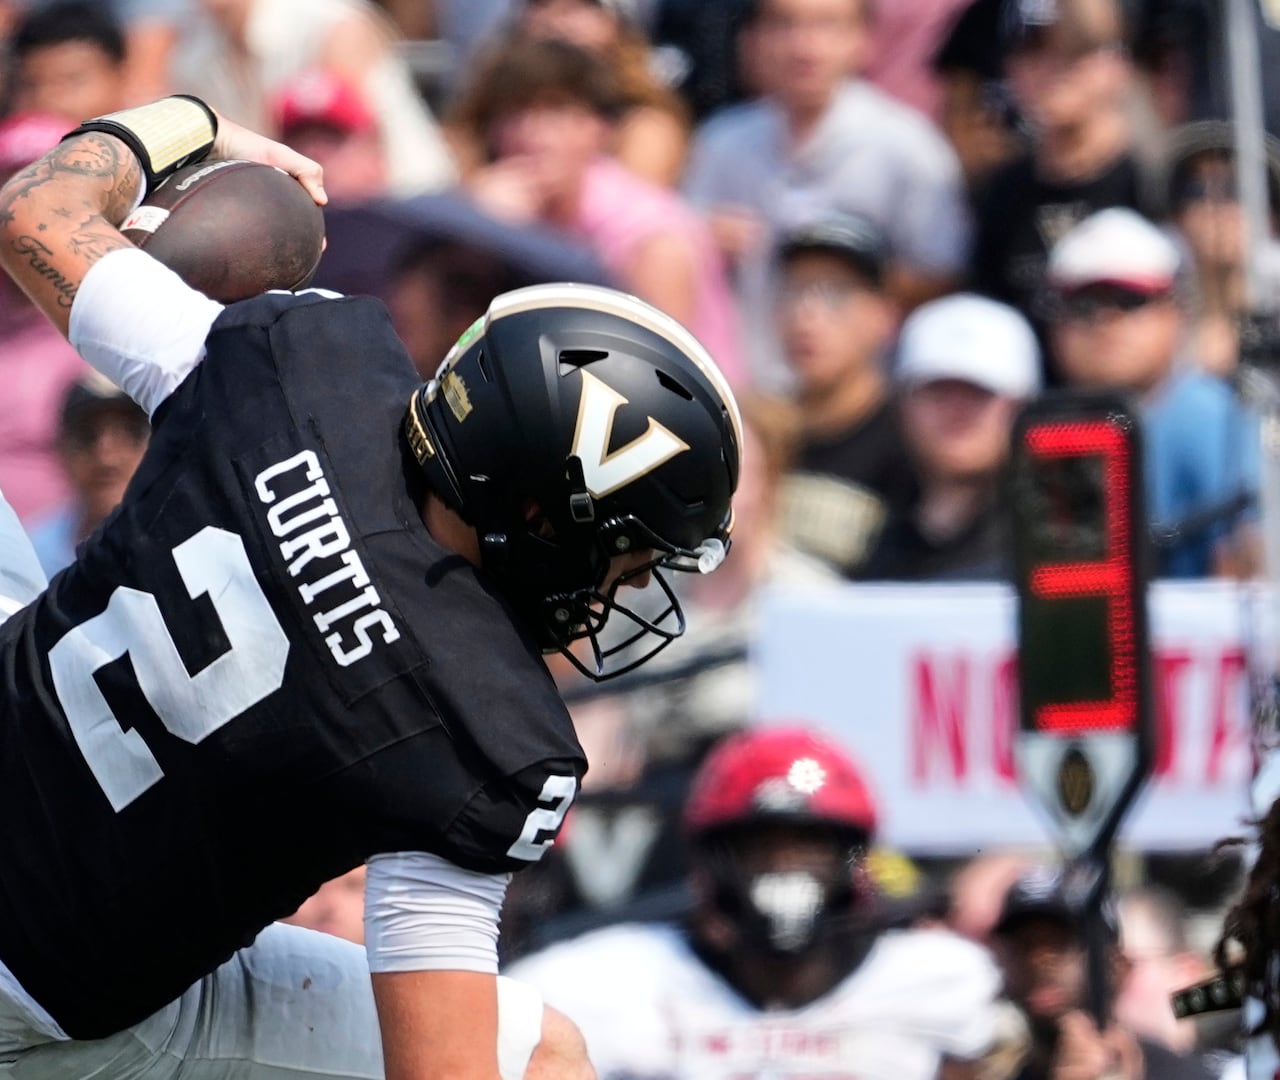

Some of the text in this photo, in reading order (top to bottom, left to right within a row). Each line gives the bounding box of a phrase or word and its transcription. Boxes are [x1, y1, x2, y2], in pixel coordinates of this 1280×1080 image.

[572, 367, 692, 500] V
[255, 449, 401, 667] CURTIS
[1024, 420, 1136, 735] 3
[47, 525, 291, 814] 2
[506, 774, 577, 861] 2
